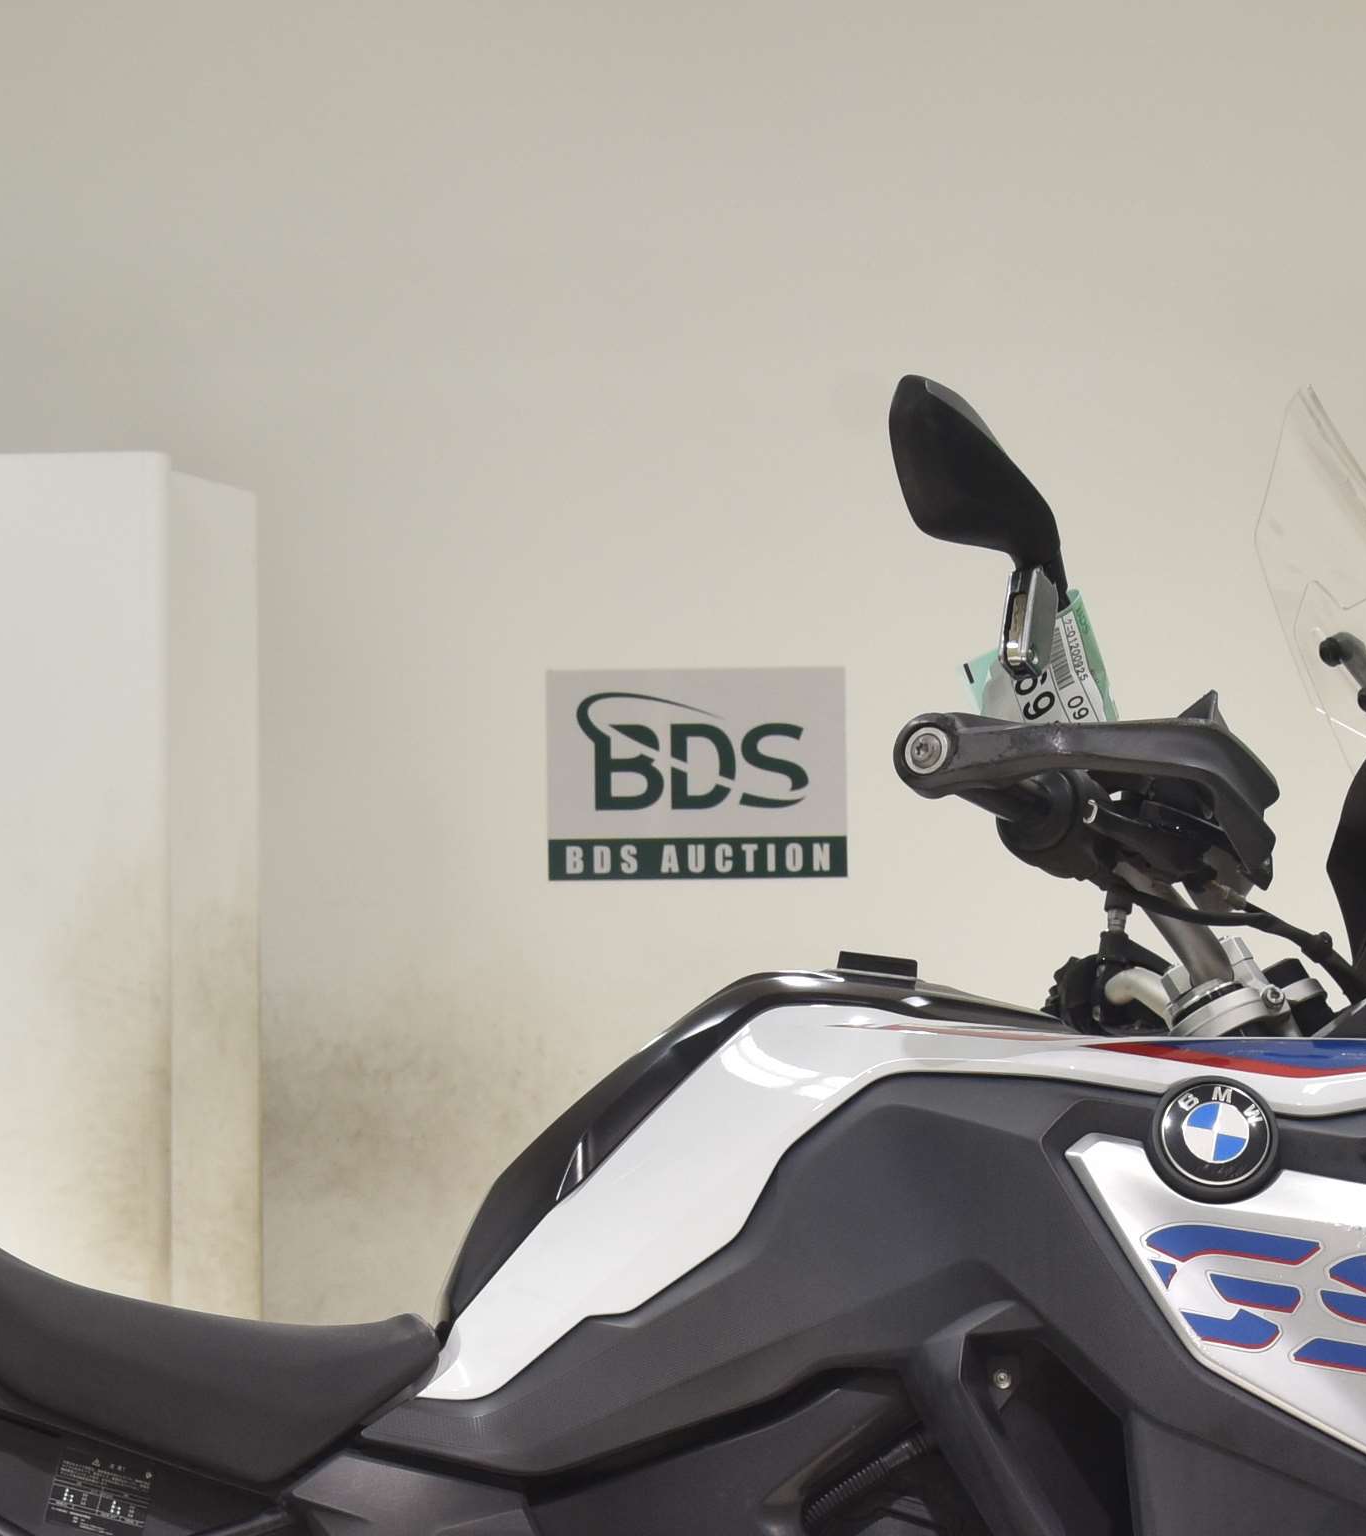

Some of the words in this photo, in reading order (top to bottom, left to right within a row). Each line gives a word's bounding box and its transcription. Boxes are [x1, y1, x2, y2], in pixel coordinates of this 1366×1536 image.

[1067, 695, 1089, 721] 09
[576, 692, 809, 811] BDS
[565, 844, 638, 875] BDS
[660, 843, 831, 874] AUCTION
[1177, 1086, 1263, 1127] BMW
